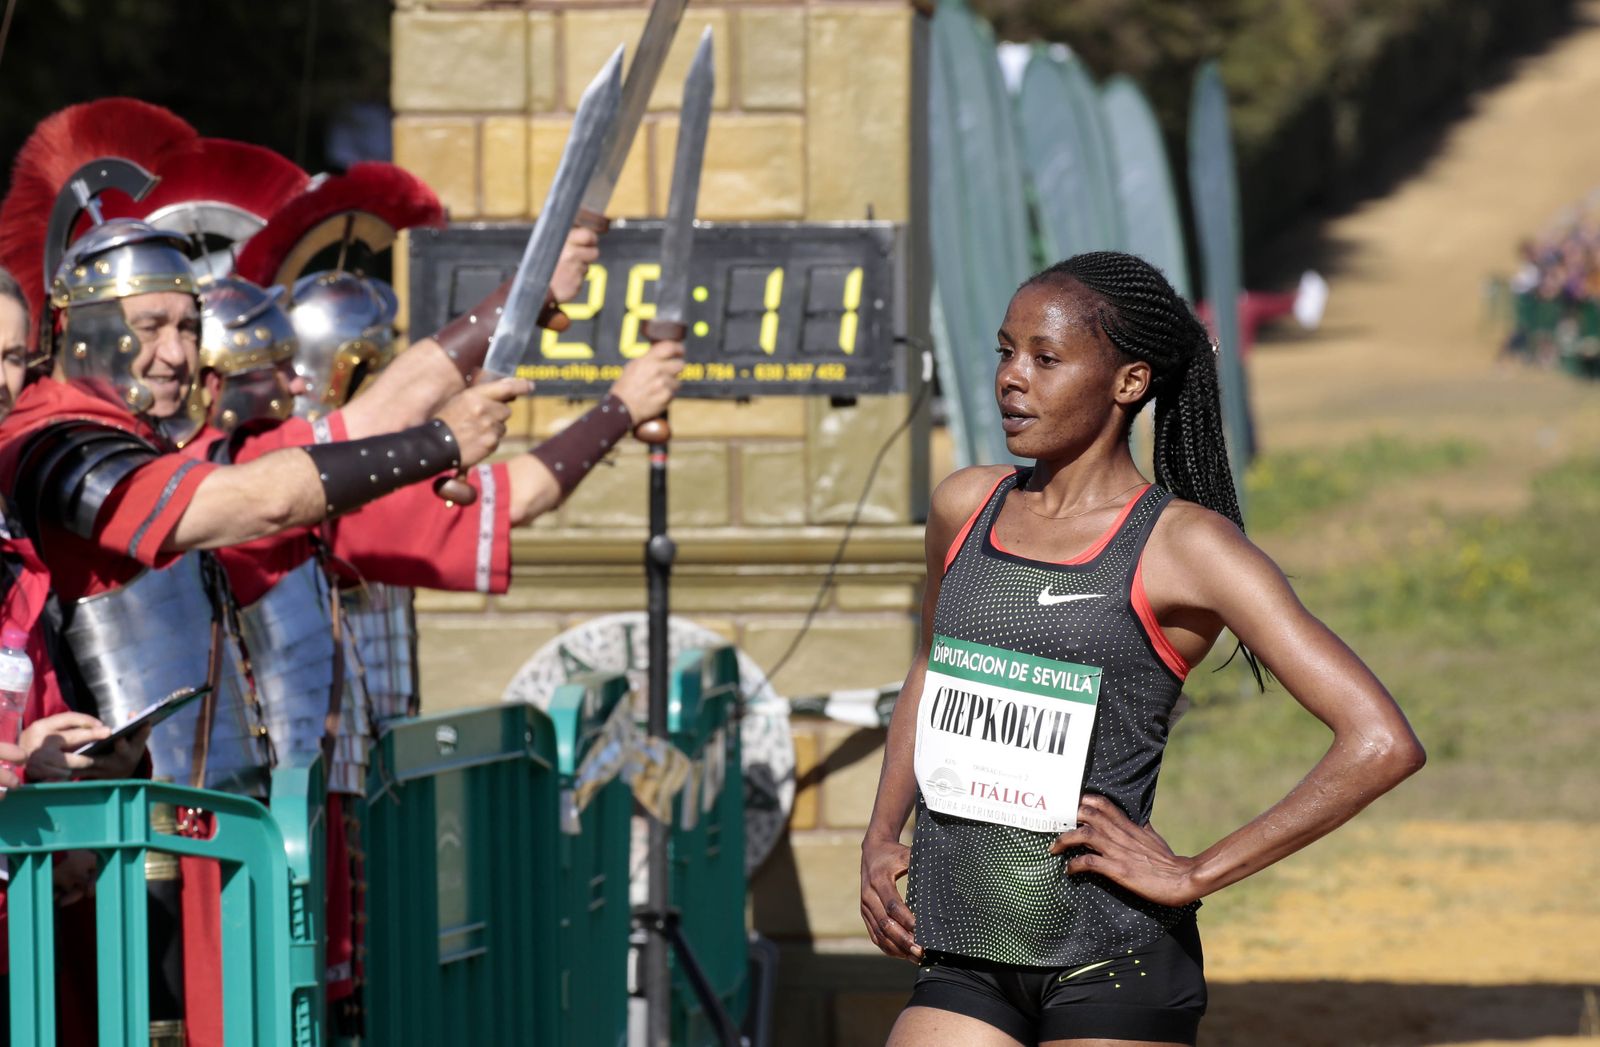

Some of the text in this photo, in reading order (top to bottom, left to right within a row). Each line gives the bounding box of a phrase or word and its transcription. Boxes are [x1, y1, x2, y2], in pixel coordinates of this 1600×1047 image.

[933, 644, 1092, 694] DIPUTACION DE SEVILLA
[930, 686, 1072, 756] CHEPKOECH
[960, 803, 1017, 825] PATRIMONIO
[970, 781, 1047, 810] ITÁLICA
